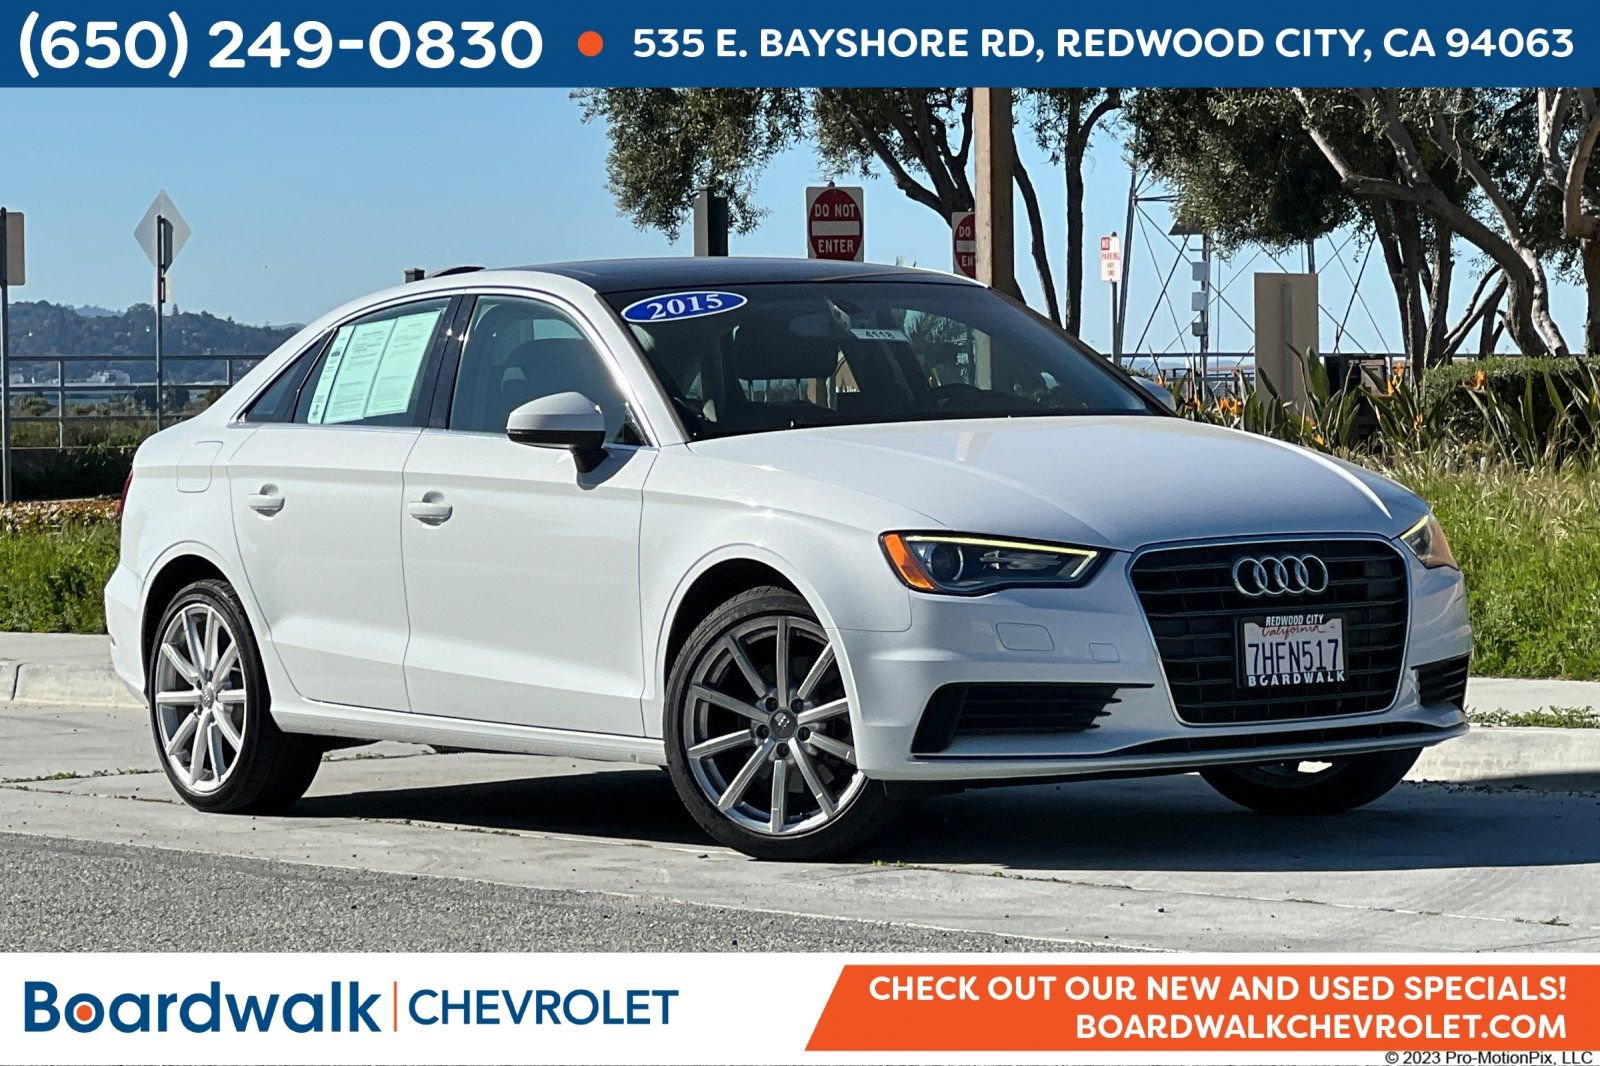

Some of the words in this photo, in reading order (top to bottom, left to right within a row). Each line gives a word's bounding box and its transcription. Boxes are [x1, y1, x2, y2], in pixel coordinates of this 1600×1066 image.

[814, 203, 830, 217] DO
[834, 203, 856, 217] NOT
[959, 226, 971, 238] DO
[818, 239, 854, 253] ENTER
[646, 293, 723, 320] 2015
[1265, 615, 1303, 626] REDWOOD
[1306, 614, 1324, 625] CITY
[1262, 625, 1325, 640] California
[1248, 670, 1345, 686] BOARDWALK
